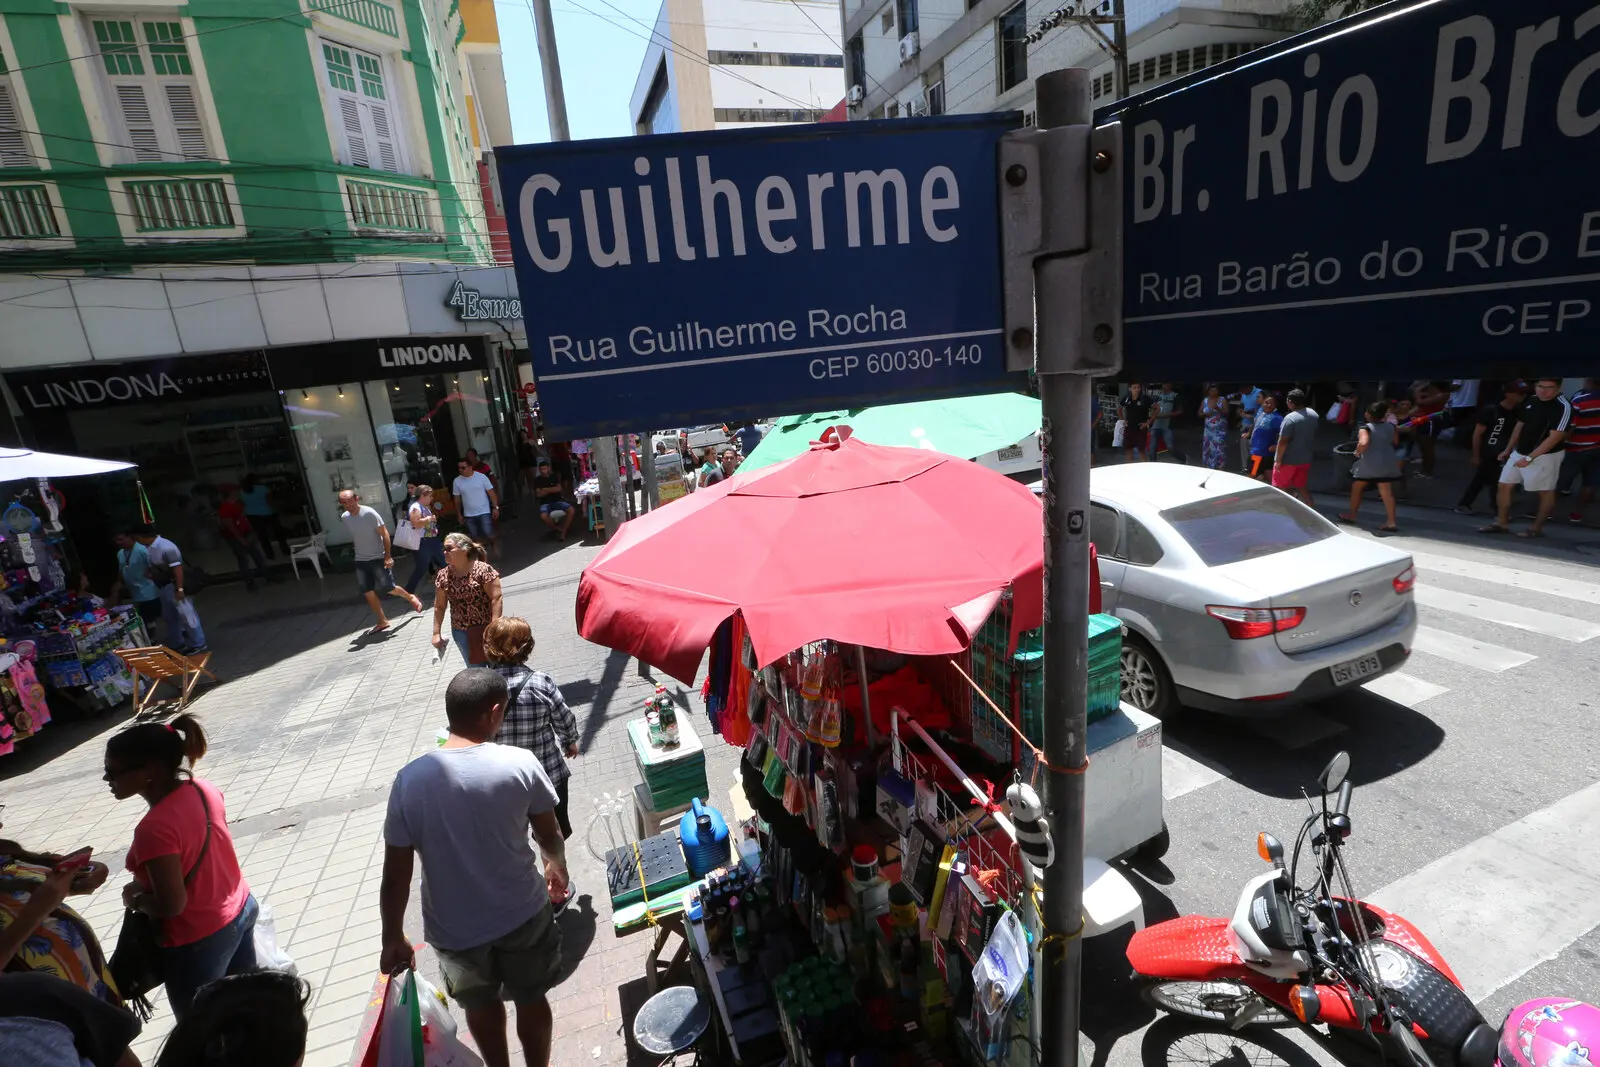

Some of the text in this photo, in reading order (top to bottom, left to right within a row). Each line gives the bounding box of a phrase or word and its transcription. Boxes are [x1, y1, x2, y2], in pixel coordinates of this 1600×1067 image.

[1133, 120, 1210, 225] Br.
[1245, 52, 1380, 201] Rio
[518, 155, 962, 274] Guilherme
[1139, 271, 1202, 303] Rua
[1217, 251, 1341, 296] Barão
[1359, 240, 1423, 281] do
[1446, 223, 1549, 272] Rio
[548, 304, 908, 365] Rua Guilherme Rocha
[1482, 299, 1591, 336] CEP
[378, 343, 472, 367] LINDONA
[808, 344, 983, 380] CEP 60030-140
[23, 372, 183, 408] LINDONA
